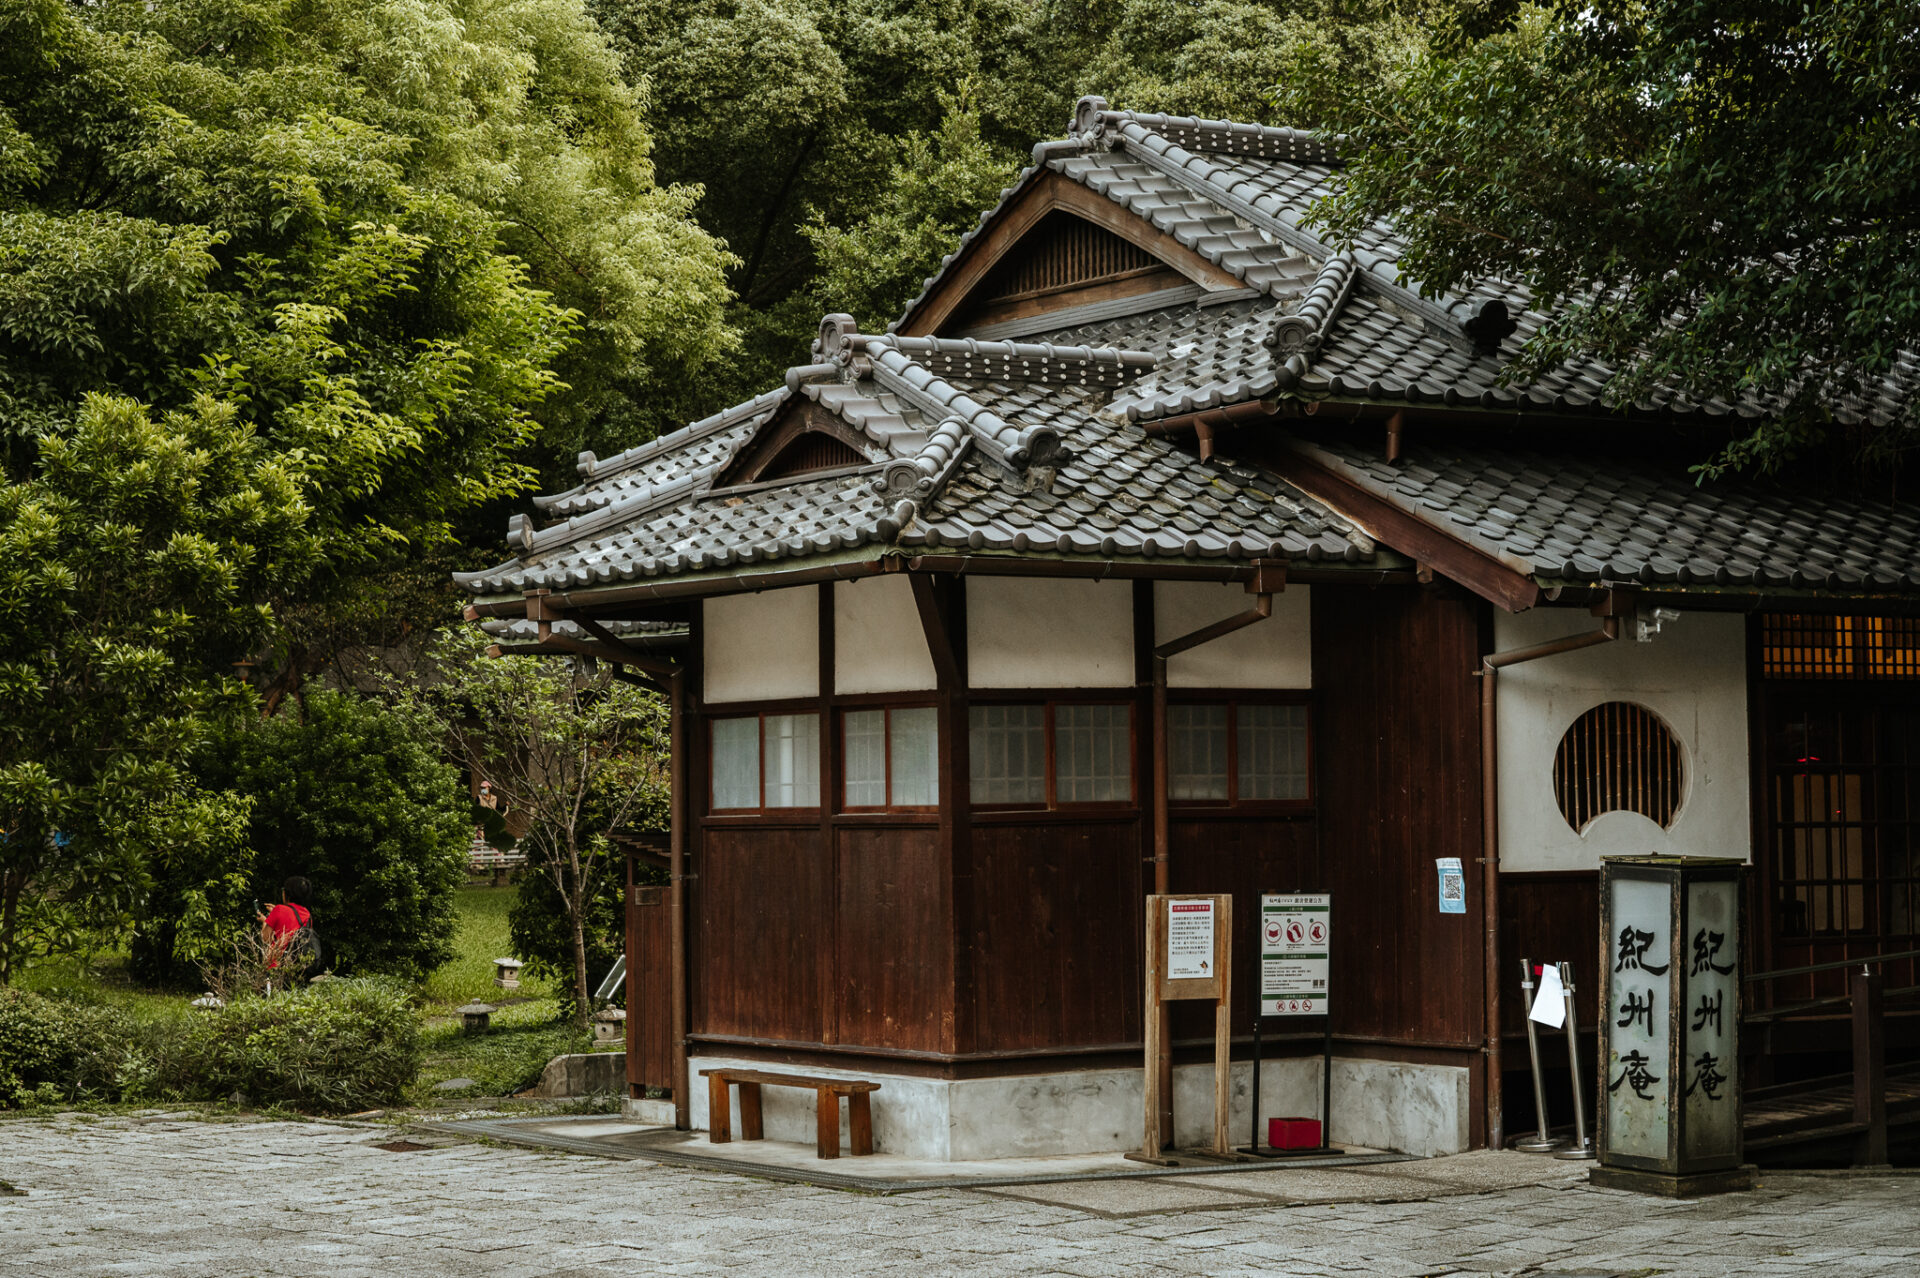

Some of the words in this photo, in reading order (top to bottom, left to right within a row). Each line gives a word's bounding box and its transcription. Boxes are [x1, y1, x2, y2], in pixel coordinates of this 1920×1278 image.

[1608, 925, 1670, 1101] 紀州庵
[1686, 927, 1736, 1101] 紀州庵
